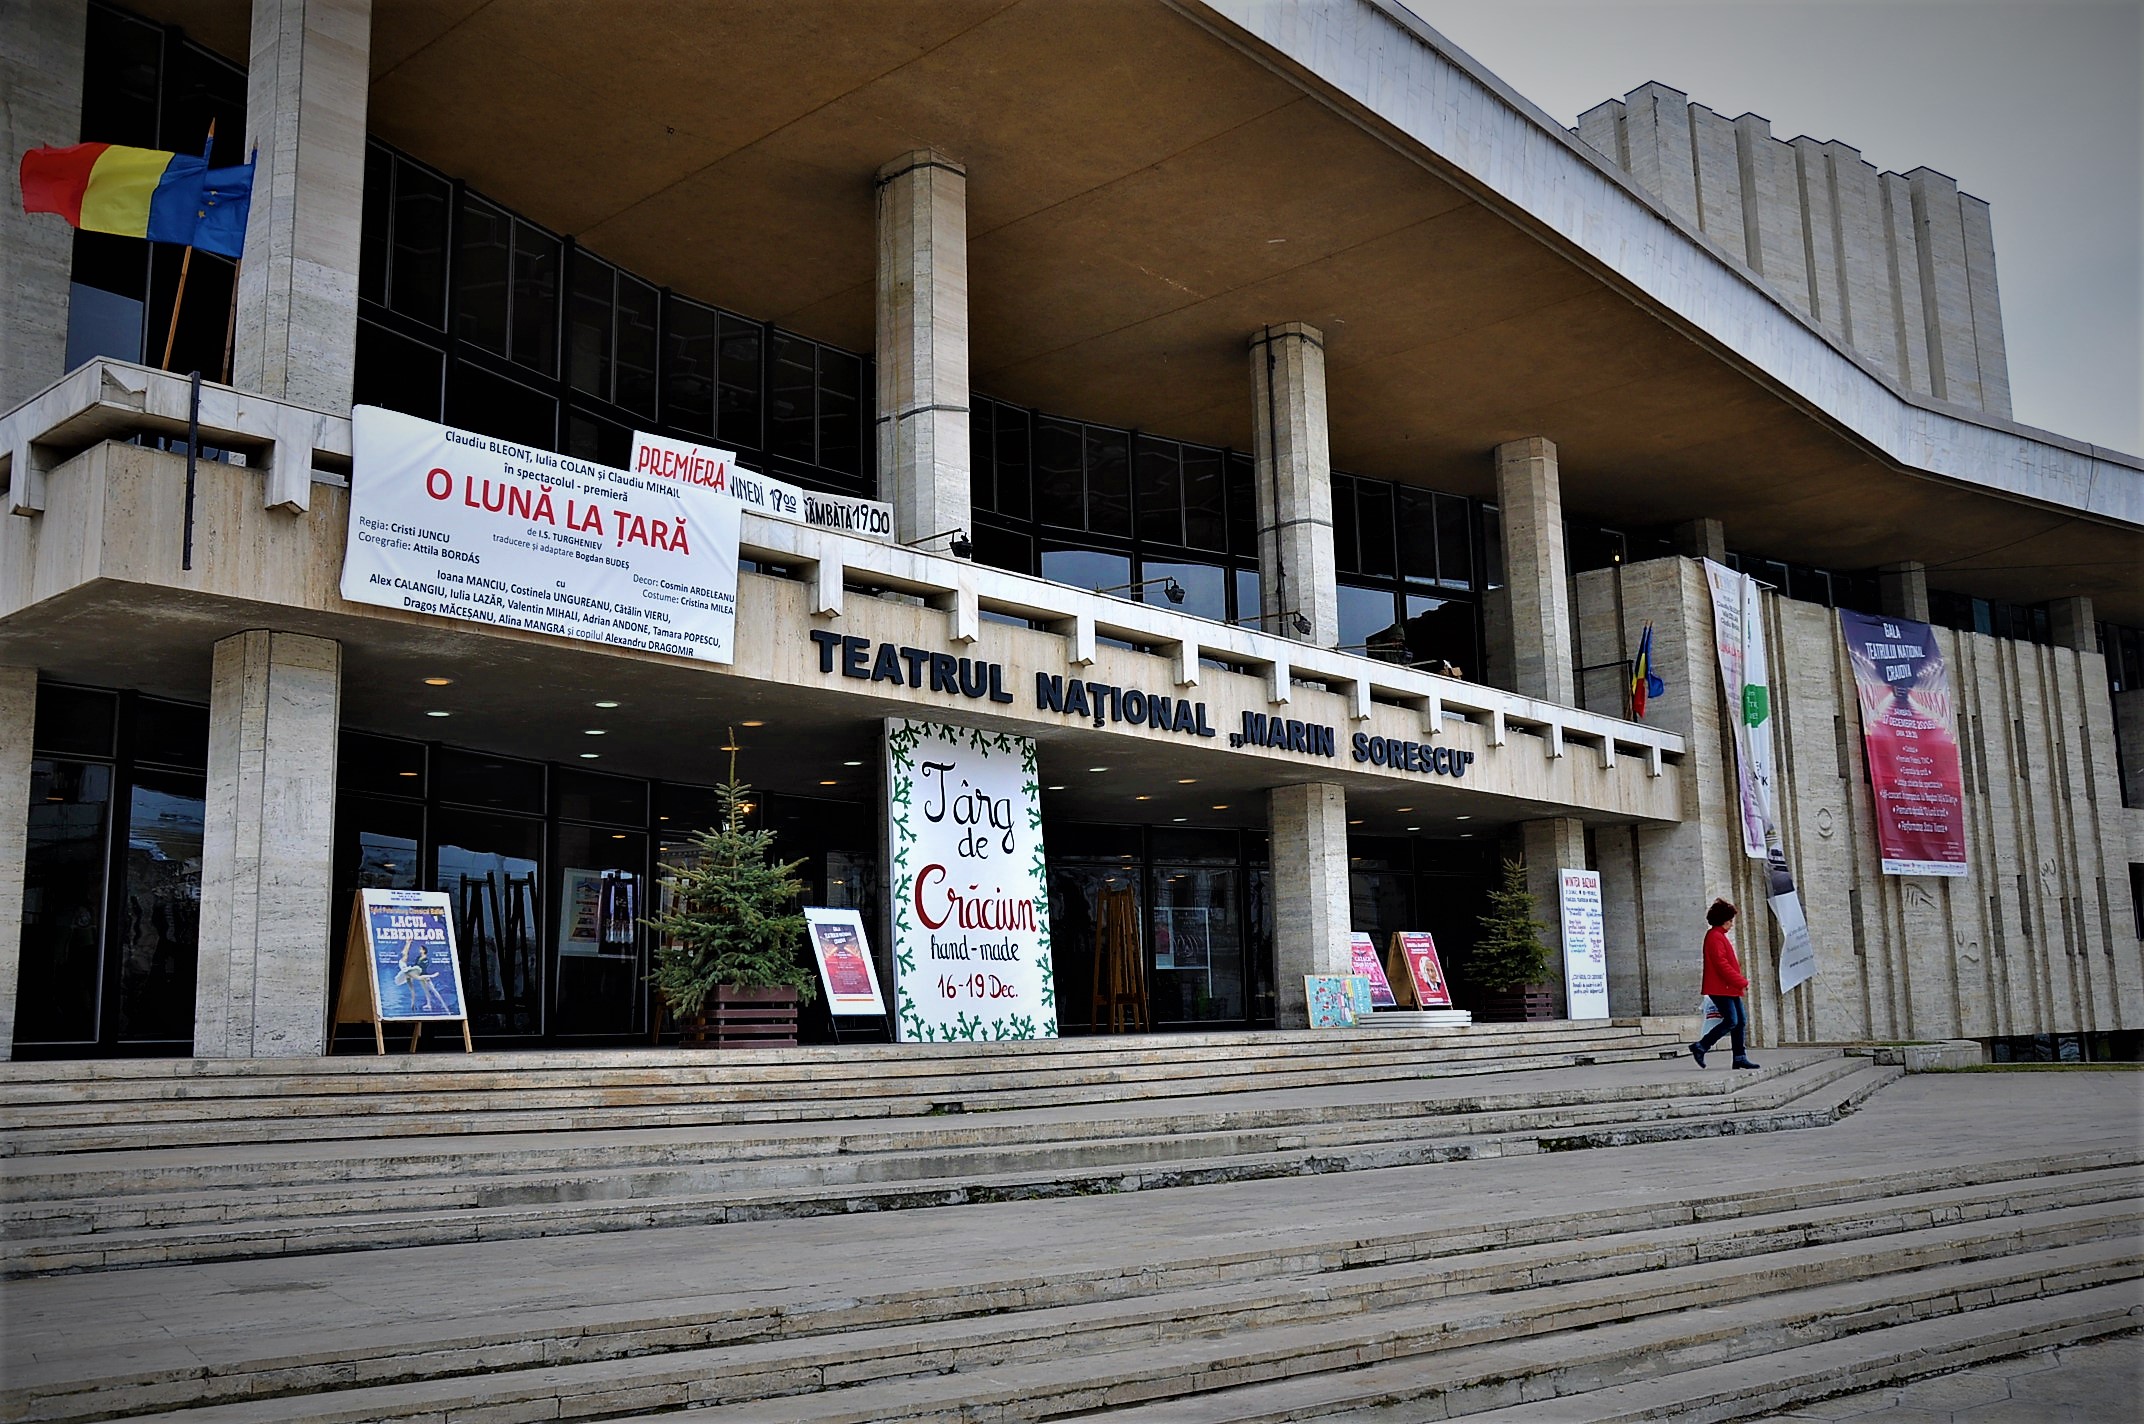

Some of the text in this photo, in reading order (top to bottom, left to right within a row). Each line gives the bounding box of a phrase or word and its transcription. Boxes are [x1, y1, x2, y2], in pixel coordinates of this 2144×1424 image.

[445, 431, 682, 499] Claudiu BLEONȚ, Iulia COLAN și Claudiu MIHAIL
[504, 462, 514, 475] în
[516, 467, 575, 489] spectacolul
[583, 484, 628, 503] premieră
[730, 475, 764, 506] VINERI
[426, 468, 690, 556] O LUNĂ LA ȚARĂ
[358, 531, 411, 552] Coregrafie:
[413, 542, 439, 557] Attila
[359, 516, 450, 543] Regia: Cristi JUNCU
[527, 527, 537, 538] de
[552, 532, 603, 551] TURGHENIEV
[492, 533, 531, 550] traducere
[540, 544, 574, 559] adaptare
[575, 551, 604, 565] Bogdan
[437, 570, 464, 584] Ioana
[466, 575, 508, 594] MANCIU,
[510, 583, 551, 601] Costinela
[553, 592, 612, 613] UNGUREANU,
[644, 608, 671, 624] VIERU,
[633, 573, 735, 604] Decor: Cosmin ARDELEANU
[642, 588, 734, 616] Costume: Cristina MILEA
[369, 573, 392, 587] Alex
[394, 577, 448, 598] CALANGIU,
[450, 587, 471, 601] Iulia
[507, 598, 544, 615] Valentin
[583, 612, 611, 627] Adrian
[612, 618, 651, 636] ANDONE,
[653, 625, 682, 640] Tamara
[684, 632, 721, 649] POPESCU,
[499, 614, 522, 627] Alina
[523, 618, 565, 635] MANGRA
[575, 628, 603, 642] copilul
[604, 632, 646, 649] Alexandru
[648, 640, 694, 657] DRAGOMIR
[1882, 622, 1902, 639] GALA
[810, 629, 1014, 705] TEATRUL
[1036, 671, 1216, 738] NAȚIONAL
[1885, 664, 1913, 682] CRAIOVA
[921, 761, 1015, 855] Târg
[957, 827, 989, 860] de
[914, 863, 1037, 932] Crăciun
[376, 928, 445, 941] LEBEDELOR
[390, 915, 427, 928] LACUL
[930, 933, 1021, 961] hand-made
[937, 973, 1019, 999] 16-19 Dec.
